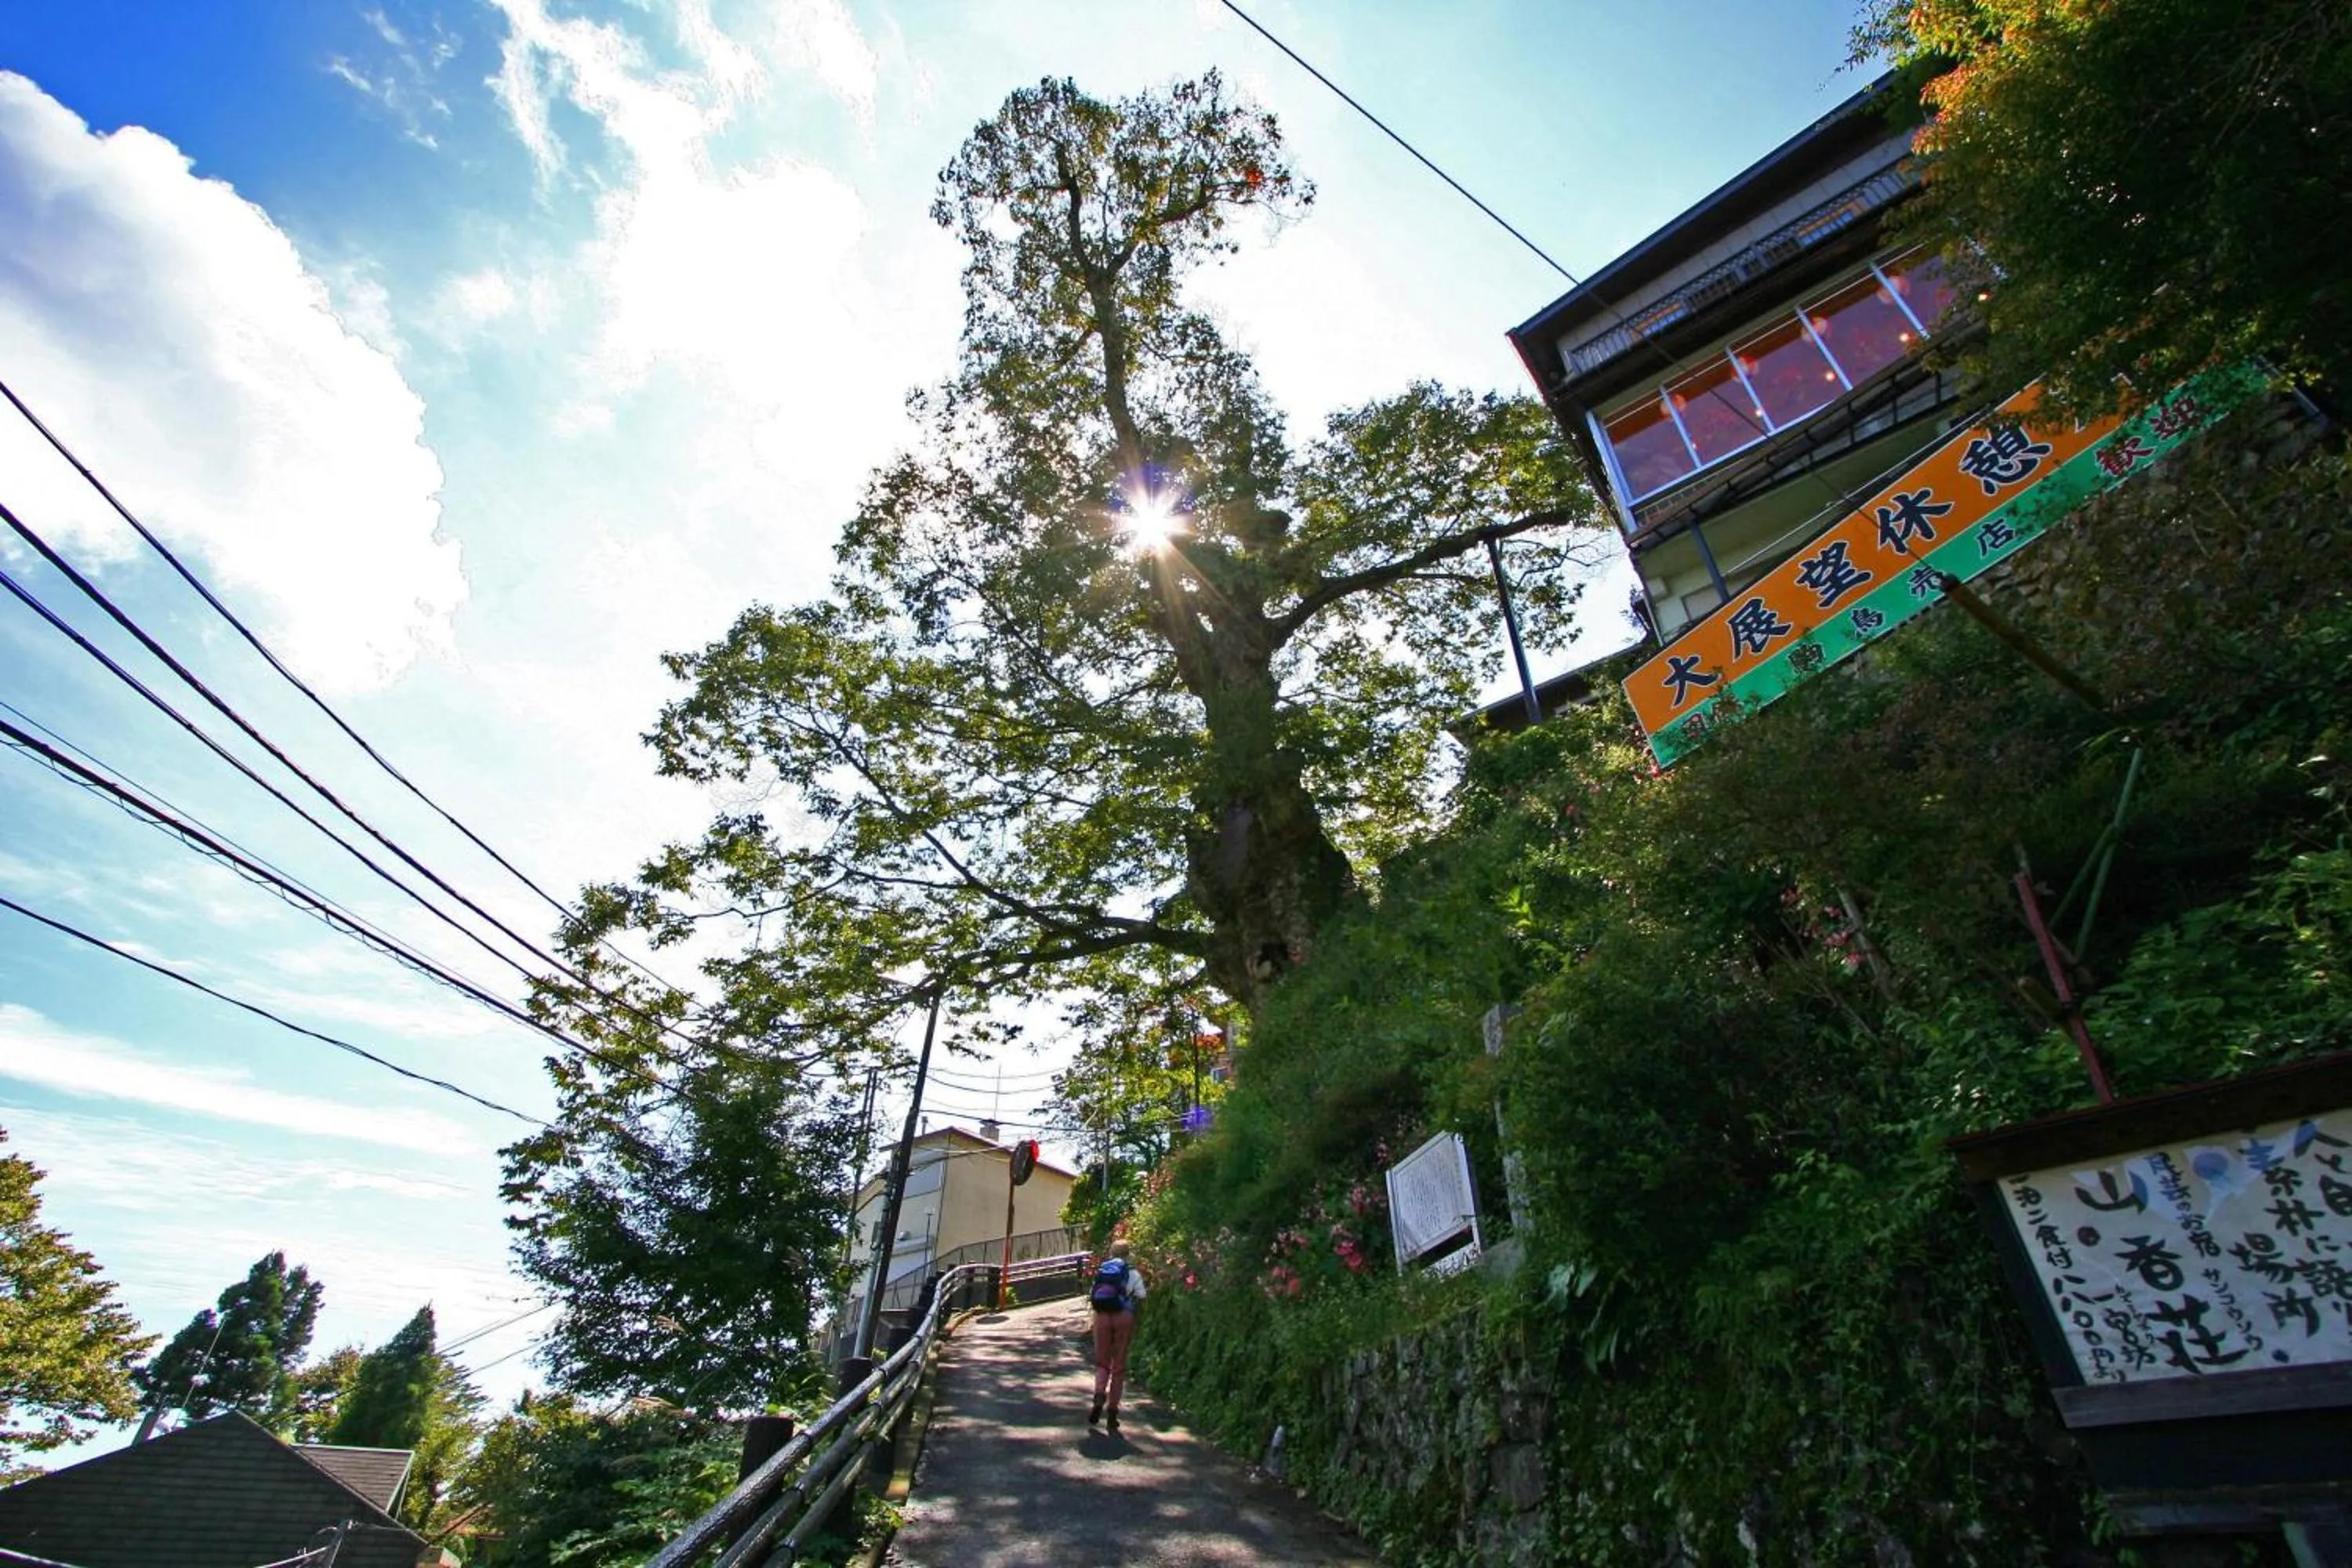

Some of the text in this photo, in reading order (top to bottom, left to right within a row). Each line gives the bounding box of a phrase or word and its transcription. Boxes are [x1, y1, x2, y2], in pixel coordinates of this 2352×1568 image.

[1661, 372, 2132, 710] 大展望休憩
[2074, 1171, 2250, 1375] 山香荘
[2294, 1119, 2352, 1248] 人と自
